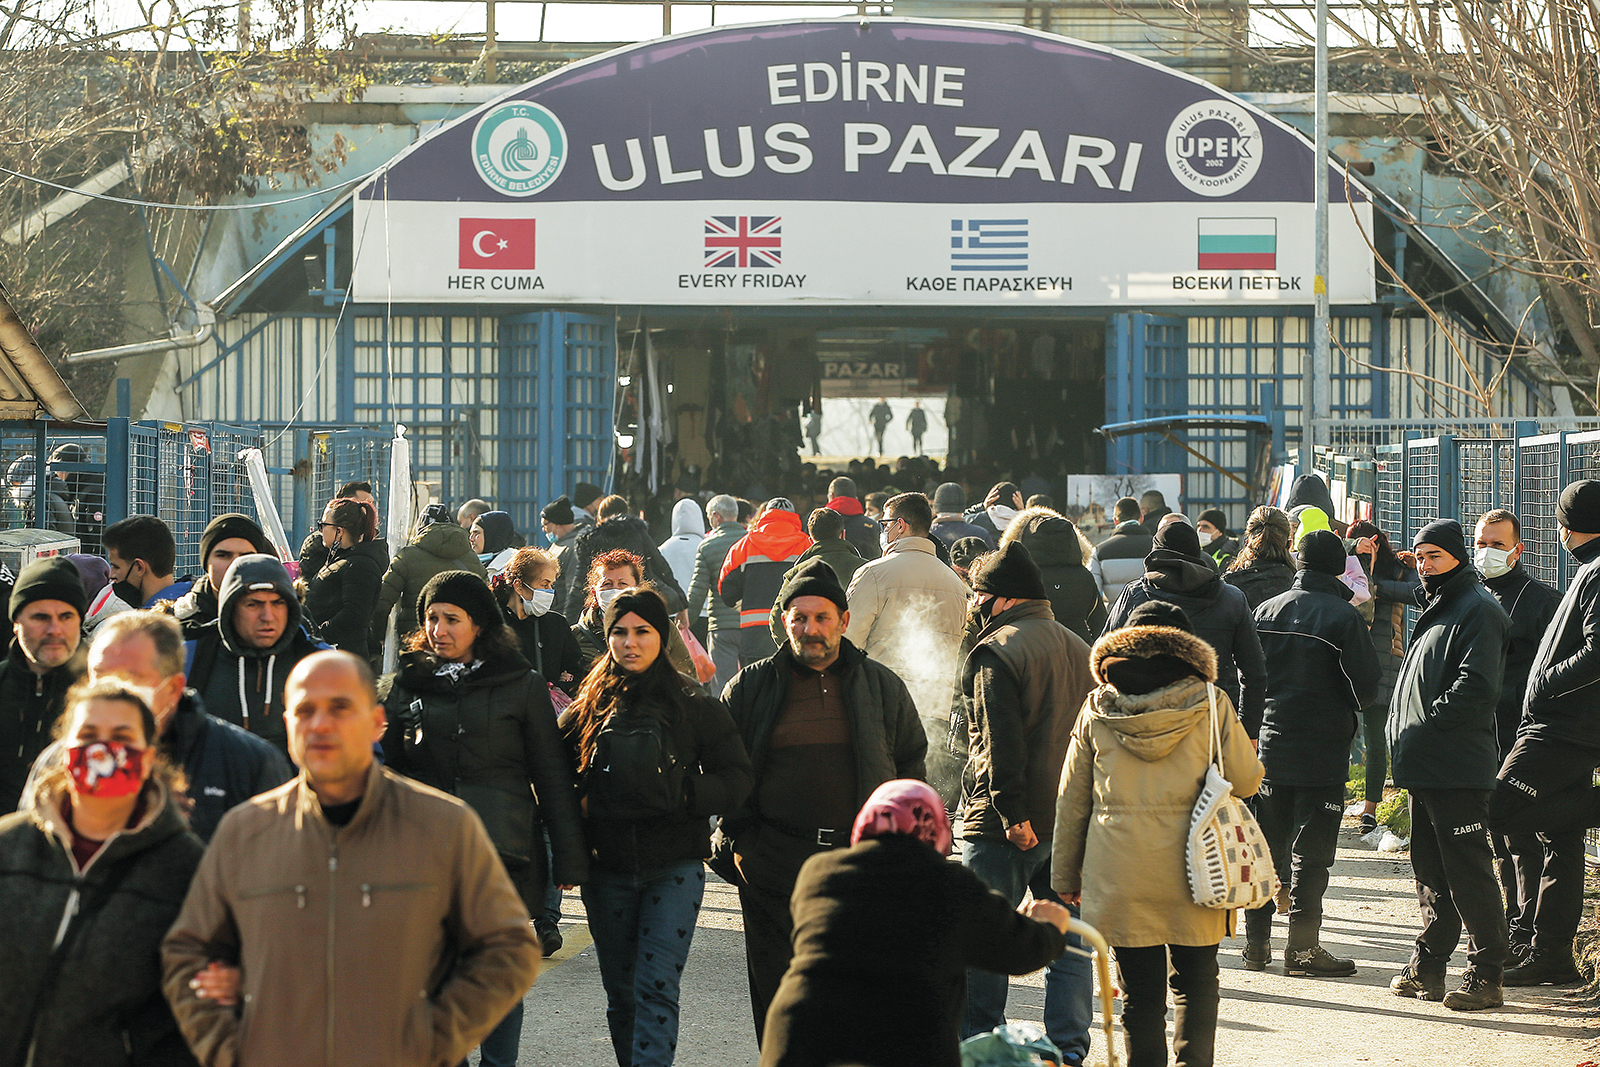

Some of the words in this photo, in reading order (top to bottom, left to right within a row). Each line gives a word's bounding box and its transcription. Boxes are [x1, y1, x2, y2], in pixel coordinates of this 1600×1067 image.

[767, 52, 966, 106] EDİRNE
[511, 107, 530, 117] T.C.
[1179, 111, 1204, 132] ULUS
[1208, 109, 1247, 133] PAZARI
[591, 122, 813, 192] ULUS
[844, 122, 1143, 192] PAZARI
[1176, 136, 1253, 159] UPEK
[479, 153, 508, 188] EDİRNE
[508, 155, 560, 191] BELEDİYESİ
[1176, 159, 1198, 182] ESNAF
[1205, 159, 1224, 168] 2002
[448, 275, 485, 291] HER
[490, 275, 545, 291] CUMA
[678, 273, 738, 289] EVERY
[742, 273, 807, 289] FRIDAY
[906, 276, 958, 292] ΚΑΘΕ
[963, 276, 1073, 292] ΠΑΡΑΣΚΕΥΗ
[1172, 275, 1234, 291] ВСЕКИ
[1239, 275, 1302, 291] ПЕТЪК
[1507, 776, 1538, 798] ZABITA
[1453, 822, 1483, 836] ZABITA
